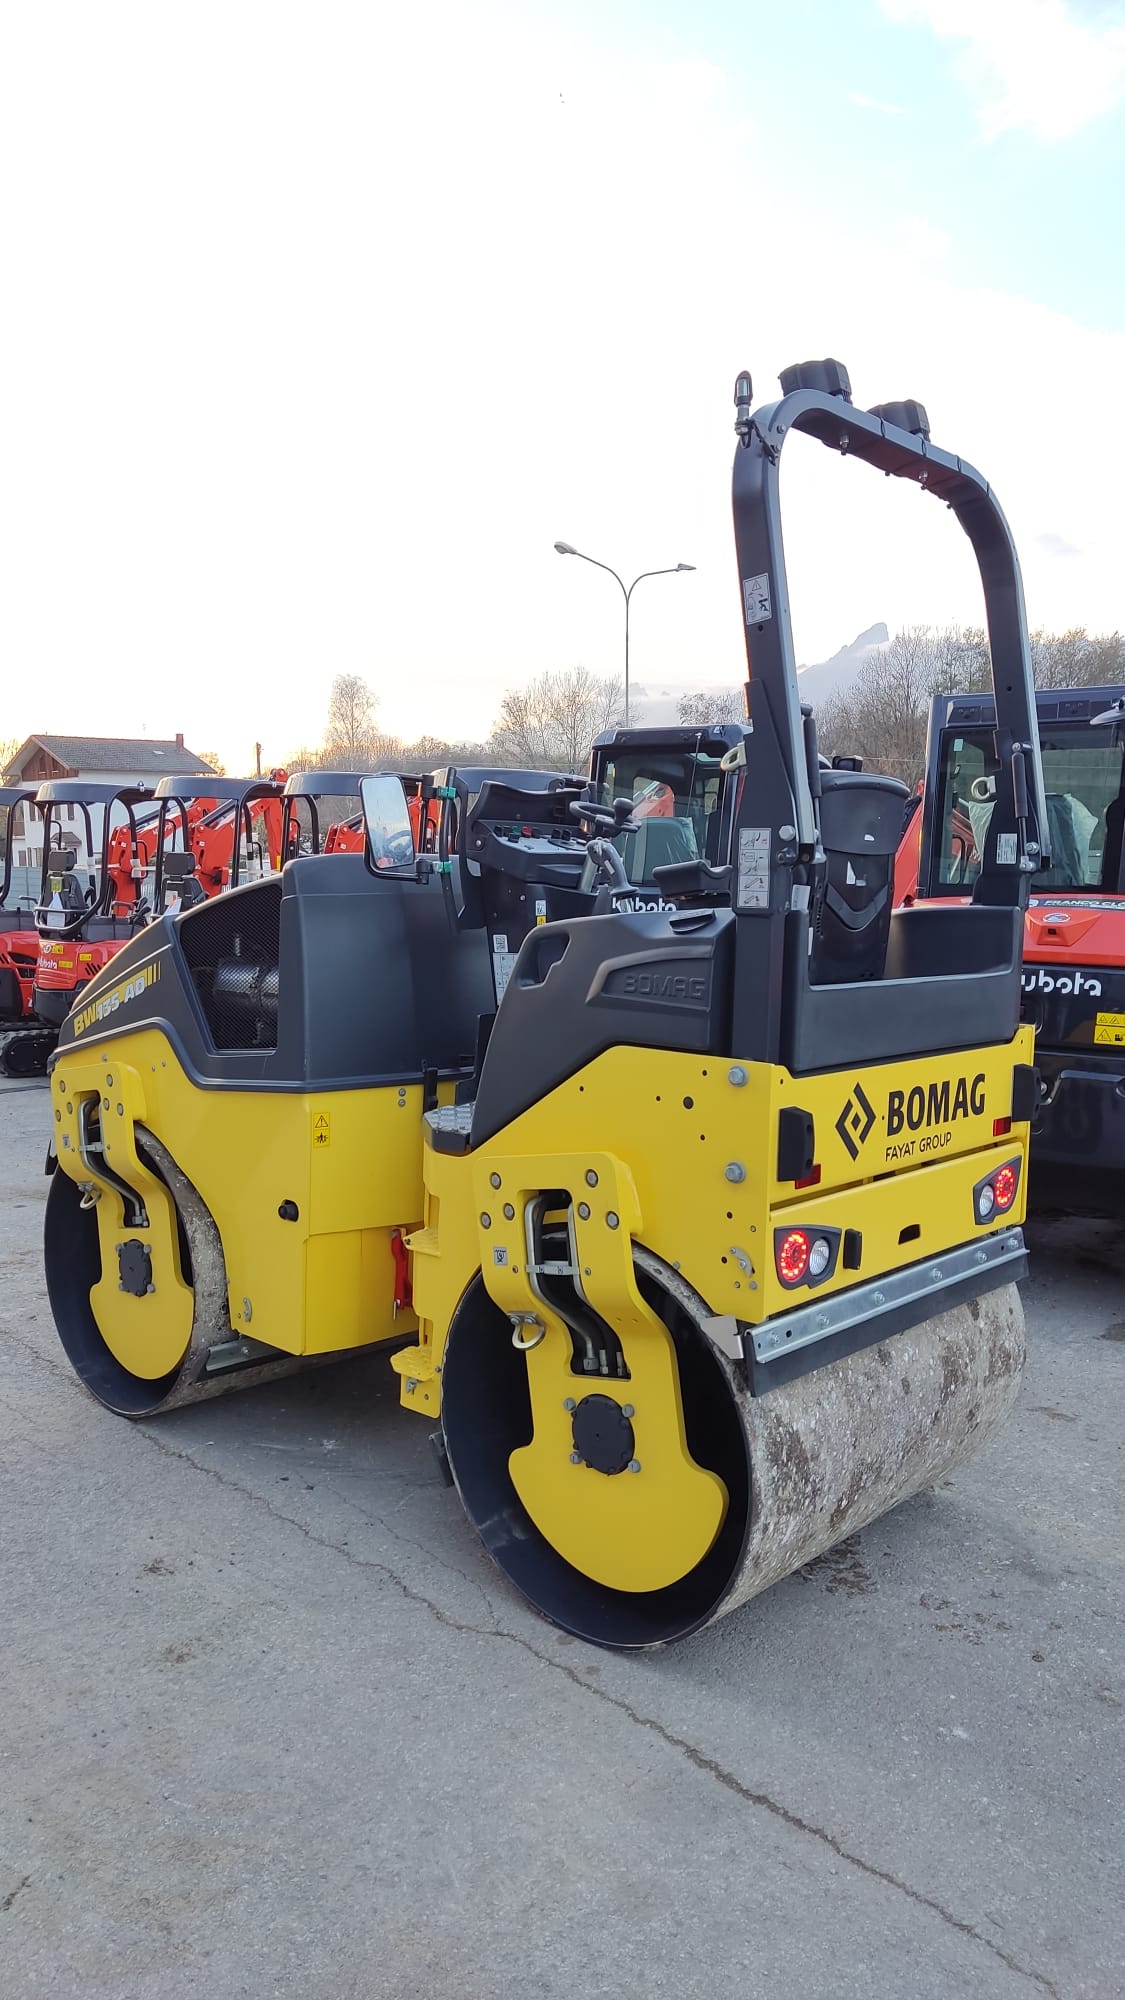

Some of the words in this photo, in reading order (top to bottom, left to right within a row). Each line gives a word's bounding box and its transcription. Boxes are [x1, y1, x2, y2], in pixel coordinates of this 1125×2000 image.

[623, 975, 705, 998] BOMAG
[1020, 968, 1102, 997] ubota
[886, 1073, 986, 1137] BOMAG
[885, 1141, 916, 1162] FAYAT
[919, 1131, 952, 1153] GROUP
